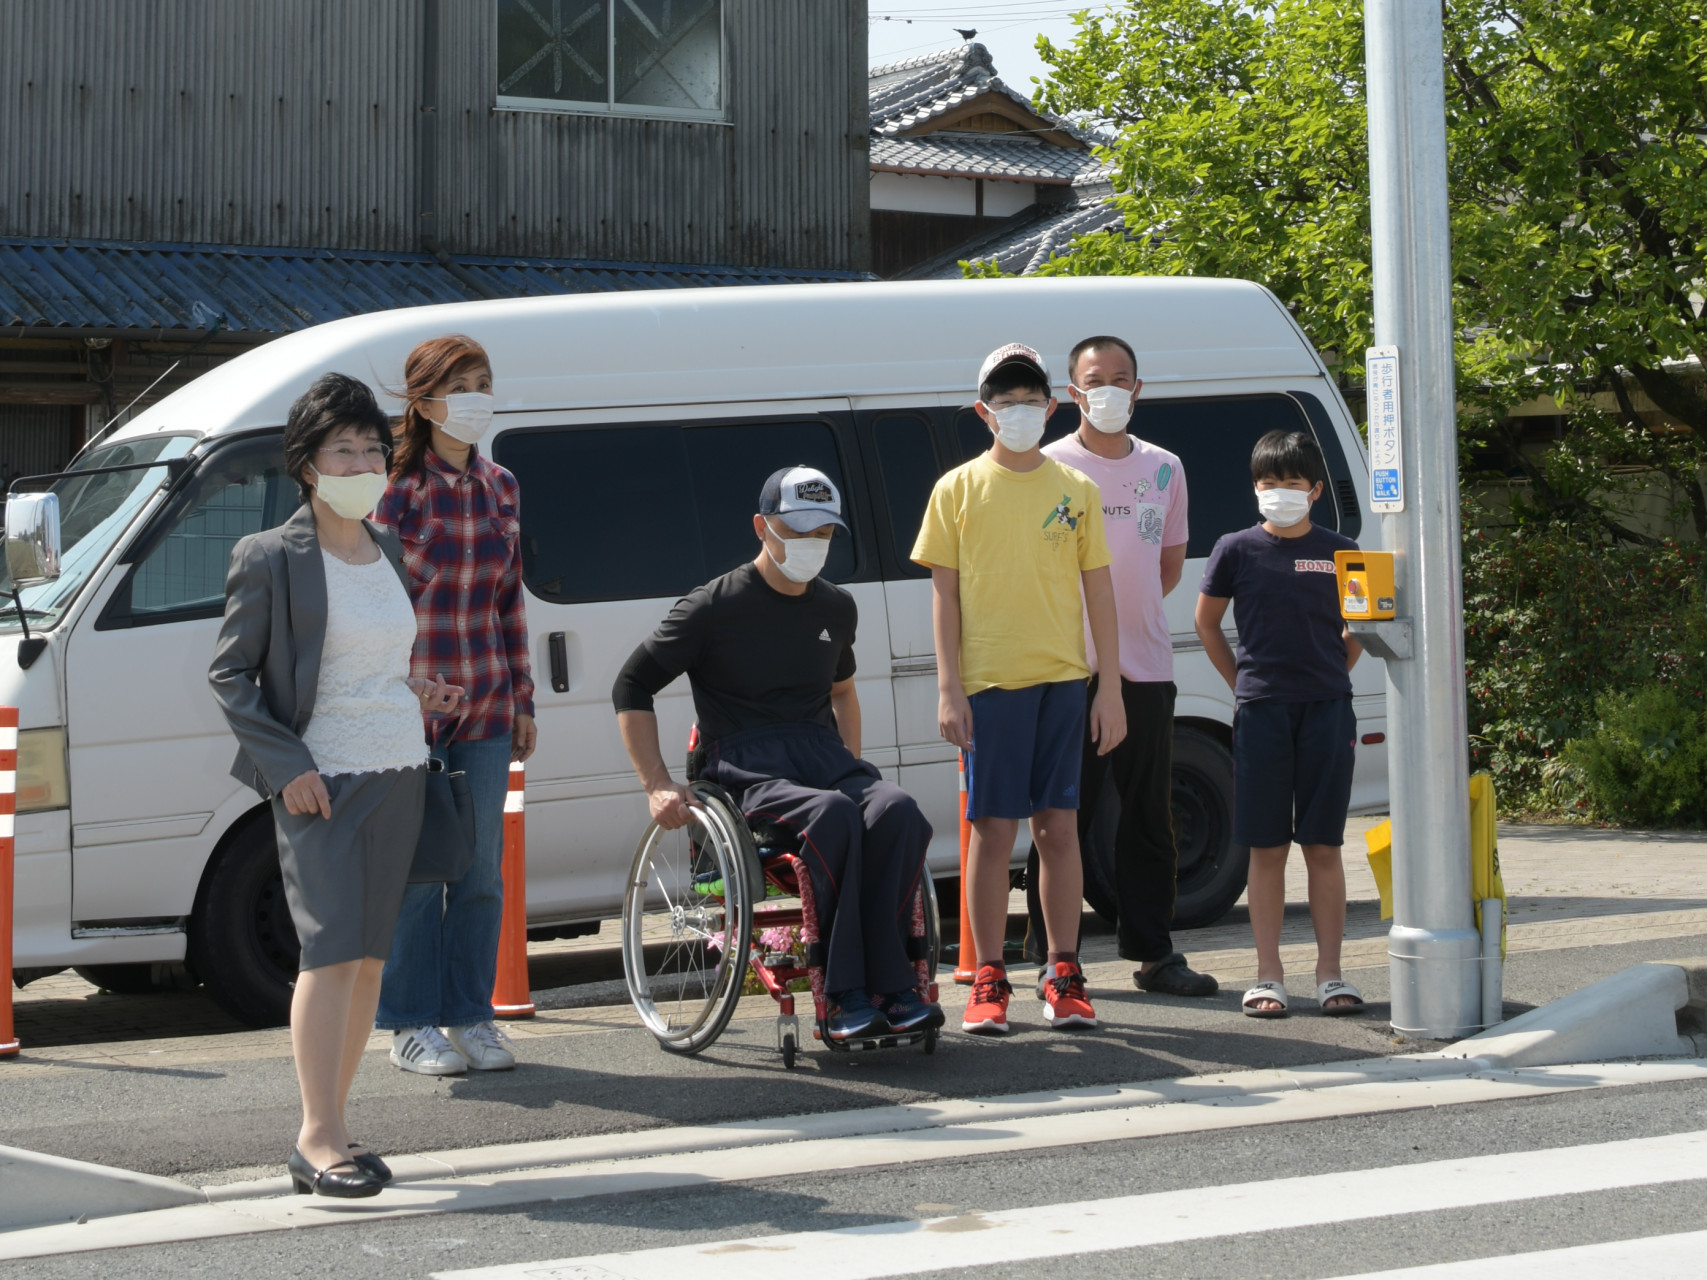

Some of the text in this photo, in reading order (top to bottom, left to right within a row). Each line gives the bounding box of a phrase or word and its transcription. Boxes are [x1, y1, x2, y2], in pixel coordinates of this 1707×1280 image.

[1381, 363, 1396, 464] 歩行者用押ボタン
[1295, 560, 1337, 574] HOND
